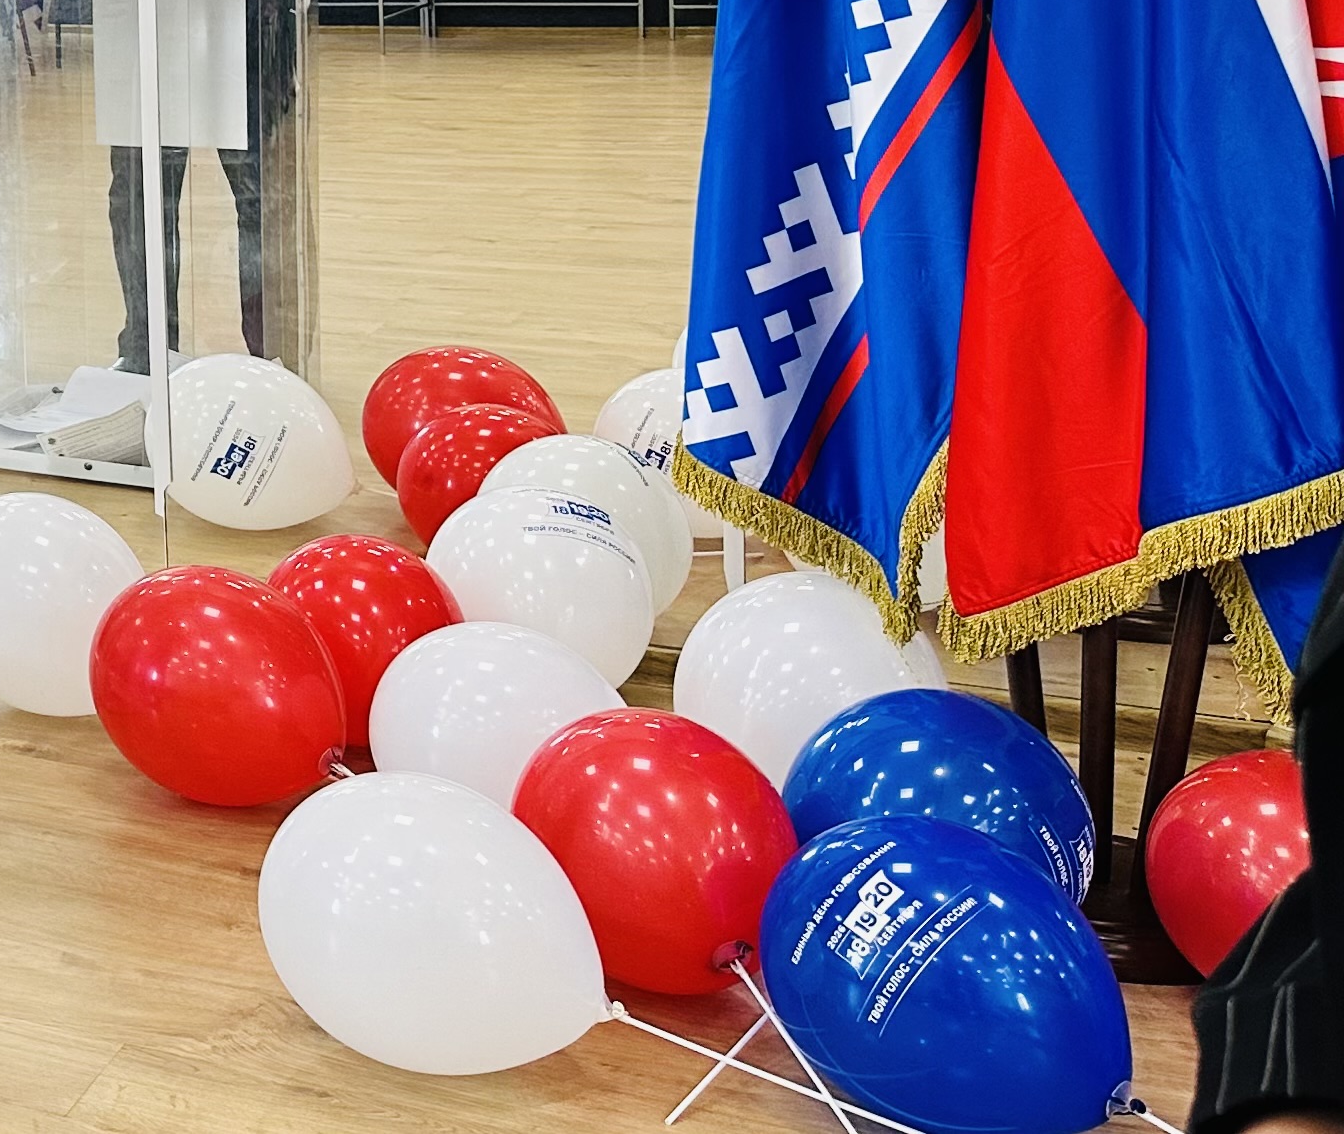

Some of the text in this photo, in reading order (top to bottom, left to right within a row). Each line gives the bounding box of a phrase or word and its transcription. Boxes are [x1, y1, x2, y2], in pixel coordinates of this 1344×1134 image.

[548, 526, 577, 535] ГОЛОС
[586, 533, 607, 545] СИЛА
[551, 505, 569, 515] 18
[1040, 826, 1068, 886] ТВОЙ ГОЛОС
[791, 841, 897, 965] ЕДИНЫЙ ДЕНЬ ГОЛОСОВАНИЯ
[846, 881, 892, 966] 18 19 20
[826, 924, 847, 950] 2026
[868, 995, 888, 1024] ТВОЙ
[882, 963, 911, 999] ГОЛОС
[913, 930, 940, 957] СИЛА
[935, 897, 978, 933] РОССИИ!
